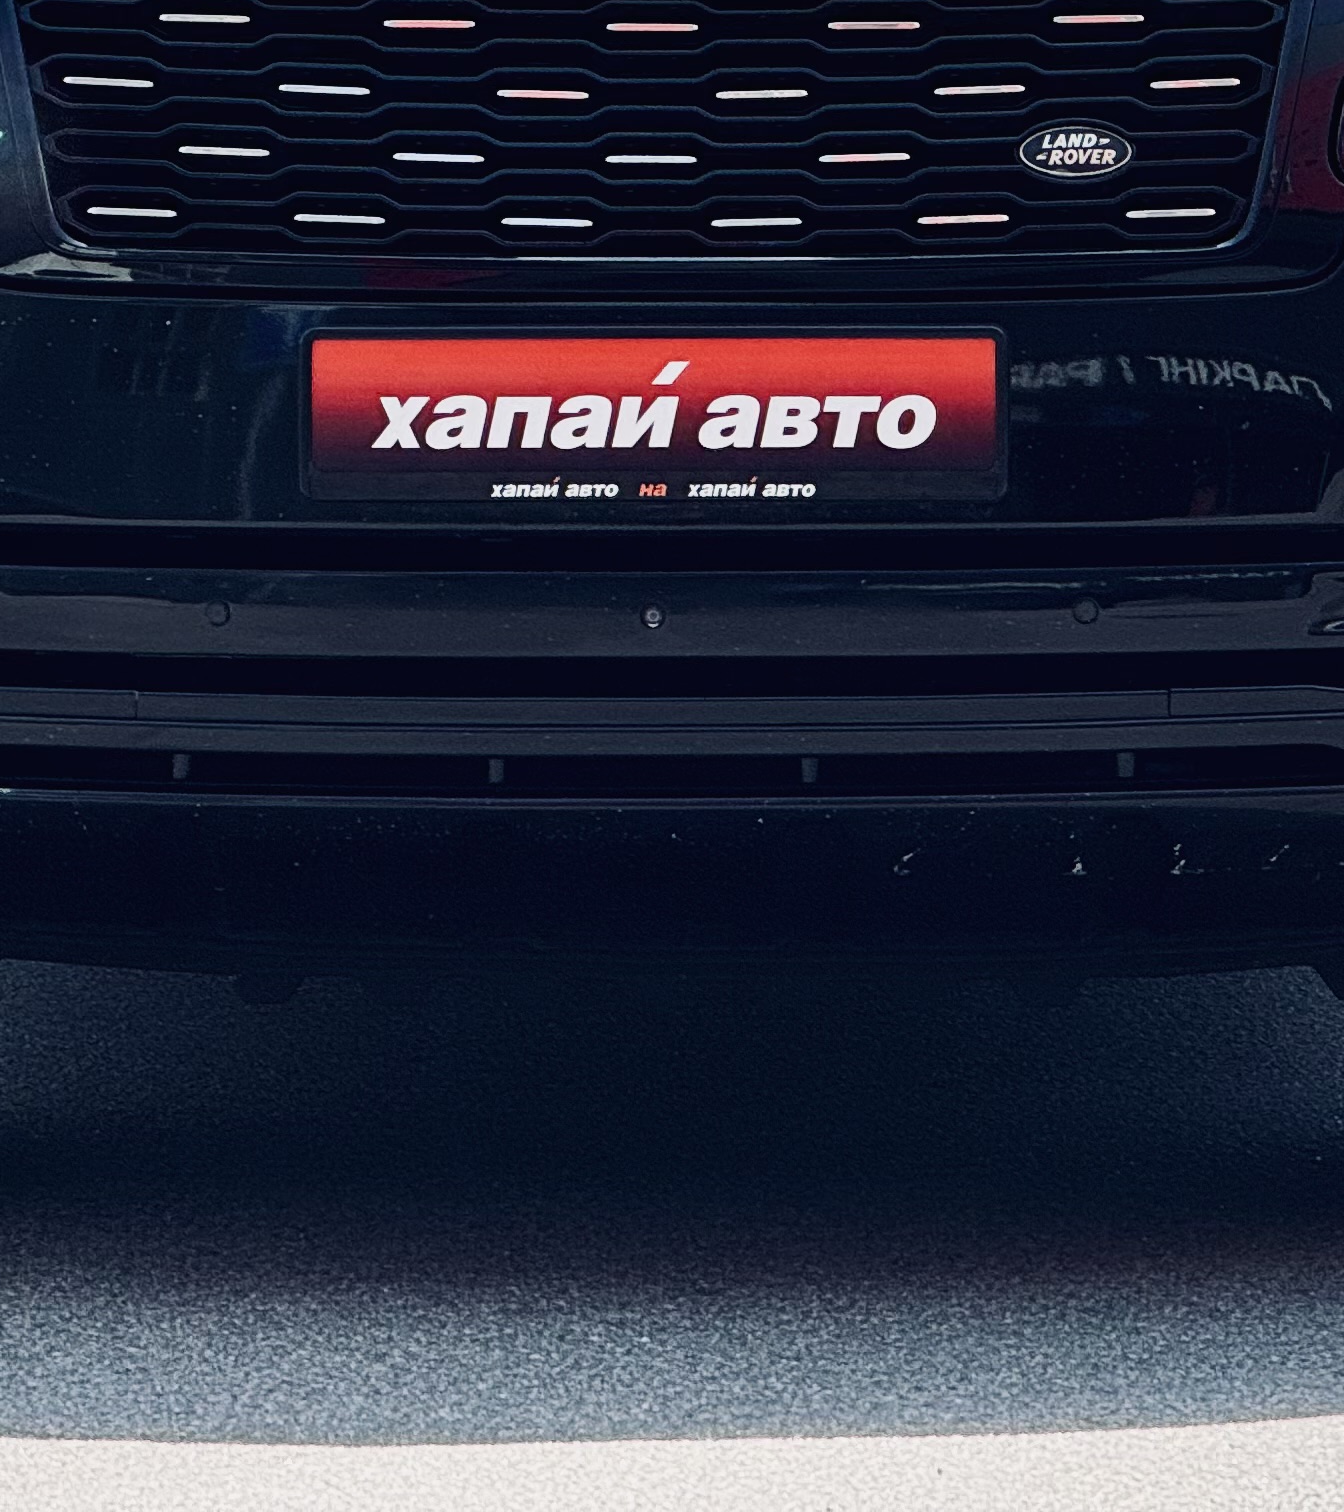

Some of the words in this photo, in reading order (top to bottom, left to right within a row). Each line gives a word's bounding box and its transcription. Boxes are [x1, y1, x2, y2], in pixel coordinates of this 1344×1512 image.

[1042, 133, 1098, 149] LAND
[1047, 148, 1117, 166] ROVER
[698, 394, 937, 449] авто
[564, 483, 619, 498] авто
[638, 484, 668, 497] на
[761, 483, 816, 498] авто
